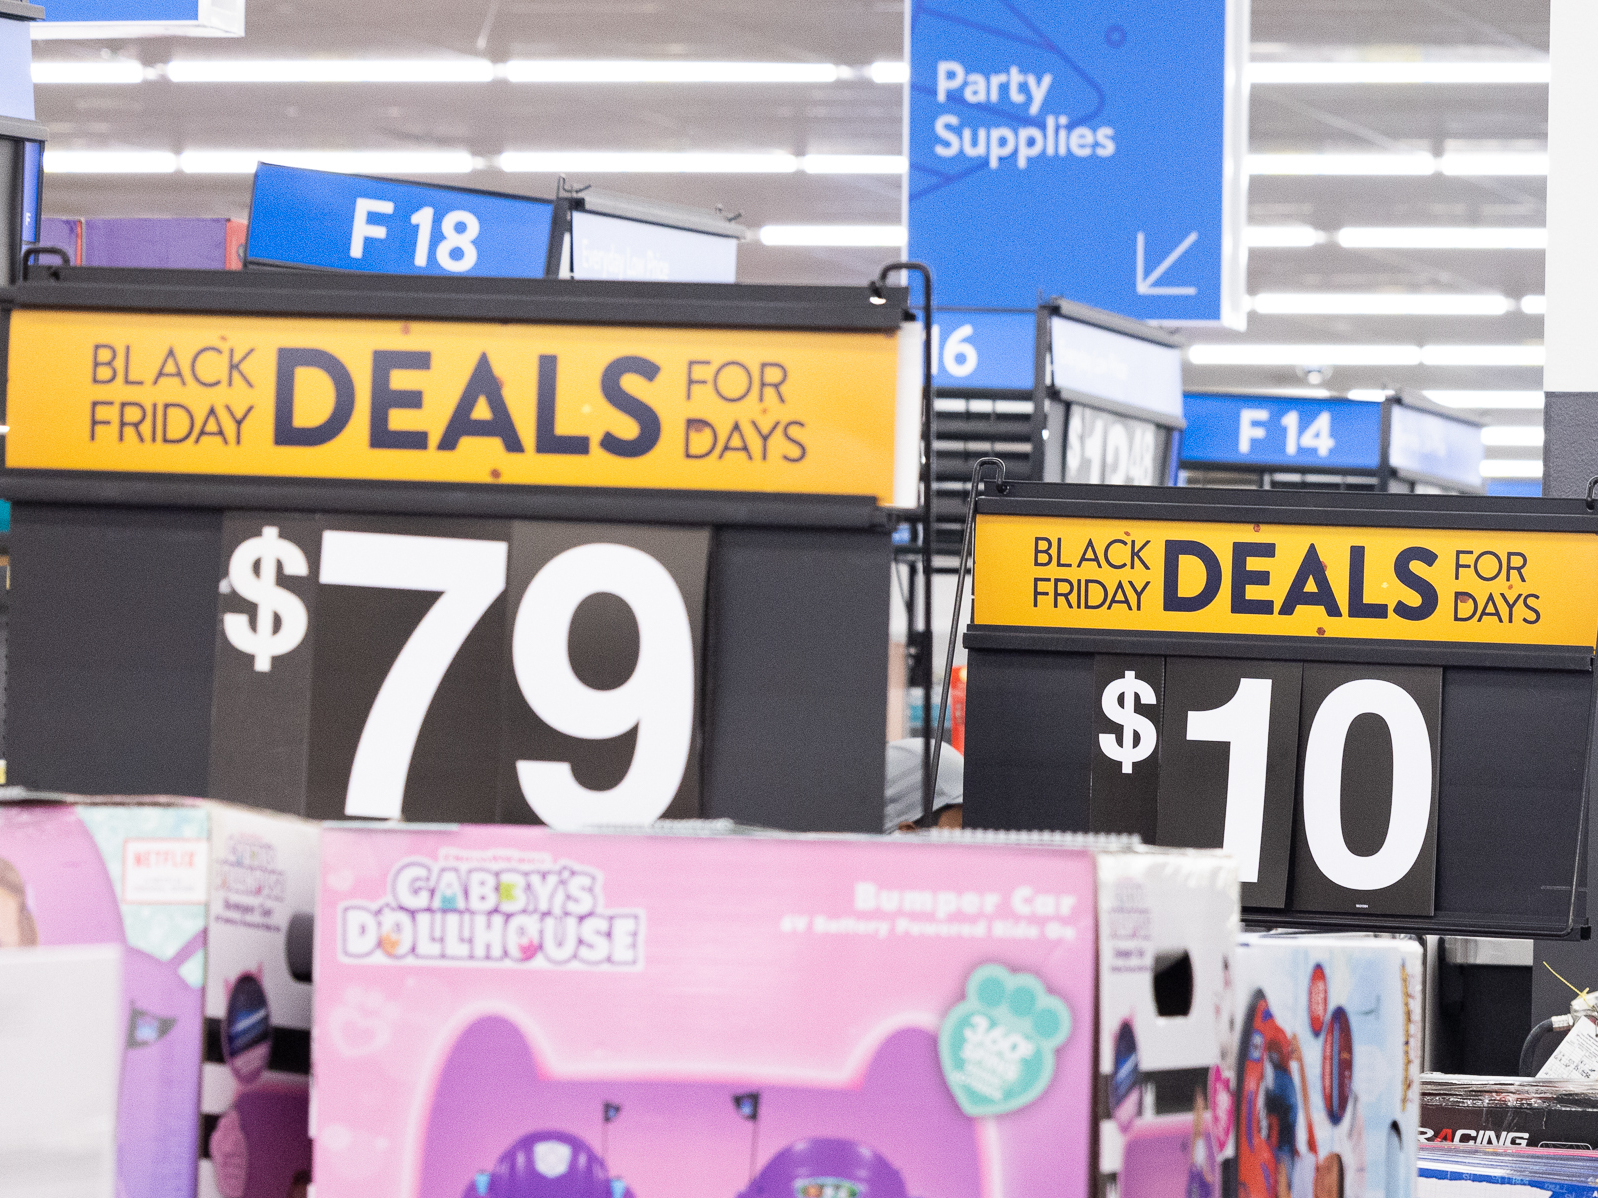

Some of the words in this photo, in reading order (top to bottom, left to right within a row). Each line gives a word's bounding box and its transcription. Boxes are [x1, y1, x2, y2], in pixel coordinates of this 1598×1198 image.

[937, 61, 1052, 115] Party
[935, 115, 1116, 170] Supplies
[350, 197, 394, 259] F
[409, 205, 481, 274] 18
[92, 344, 254, 389] BLACK
[685, 360, 788, 403] FOR
[89, 401, 254, 446] FRIDAY
[274, 346, 663, 459] DEALS
[685, 417, 807, 464] DAYS
[1239, 408, 1270, 454] F
[1281, 409, 1335, 457] 14
[1034, 536, 1151, 571] BLACK
[1455, 550, 1528, 584] FOR
[1033, 577, 1152, 613] FRIDAY
[1164, 539, 1440, 622] DEALS
[1454, 589, 1542, 626] DAYS
[1099, 670, 1432, 892] $10
[394, 861, 596, 916] GABBY'S
[854, 882, 999, 920] Bumper
[1011, 886, 1077, 917] Car
[344, 904, 640, 966] DOLLHOUSE
[812, 914, 891, 939] Battery
[896, 916, 988, 939] Powered
[1418, 1128, 1530, 1147] RACING
